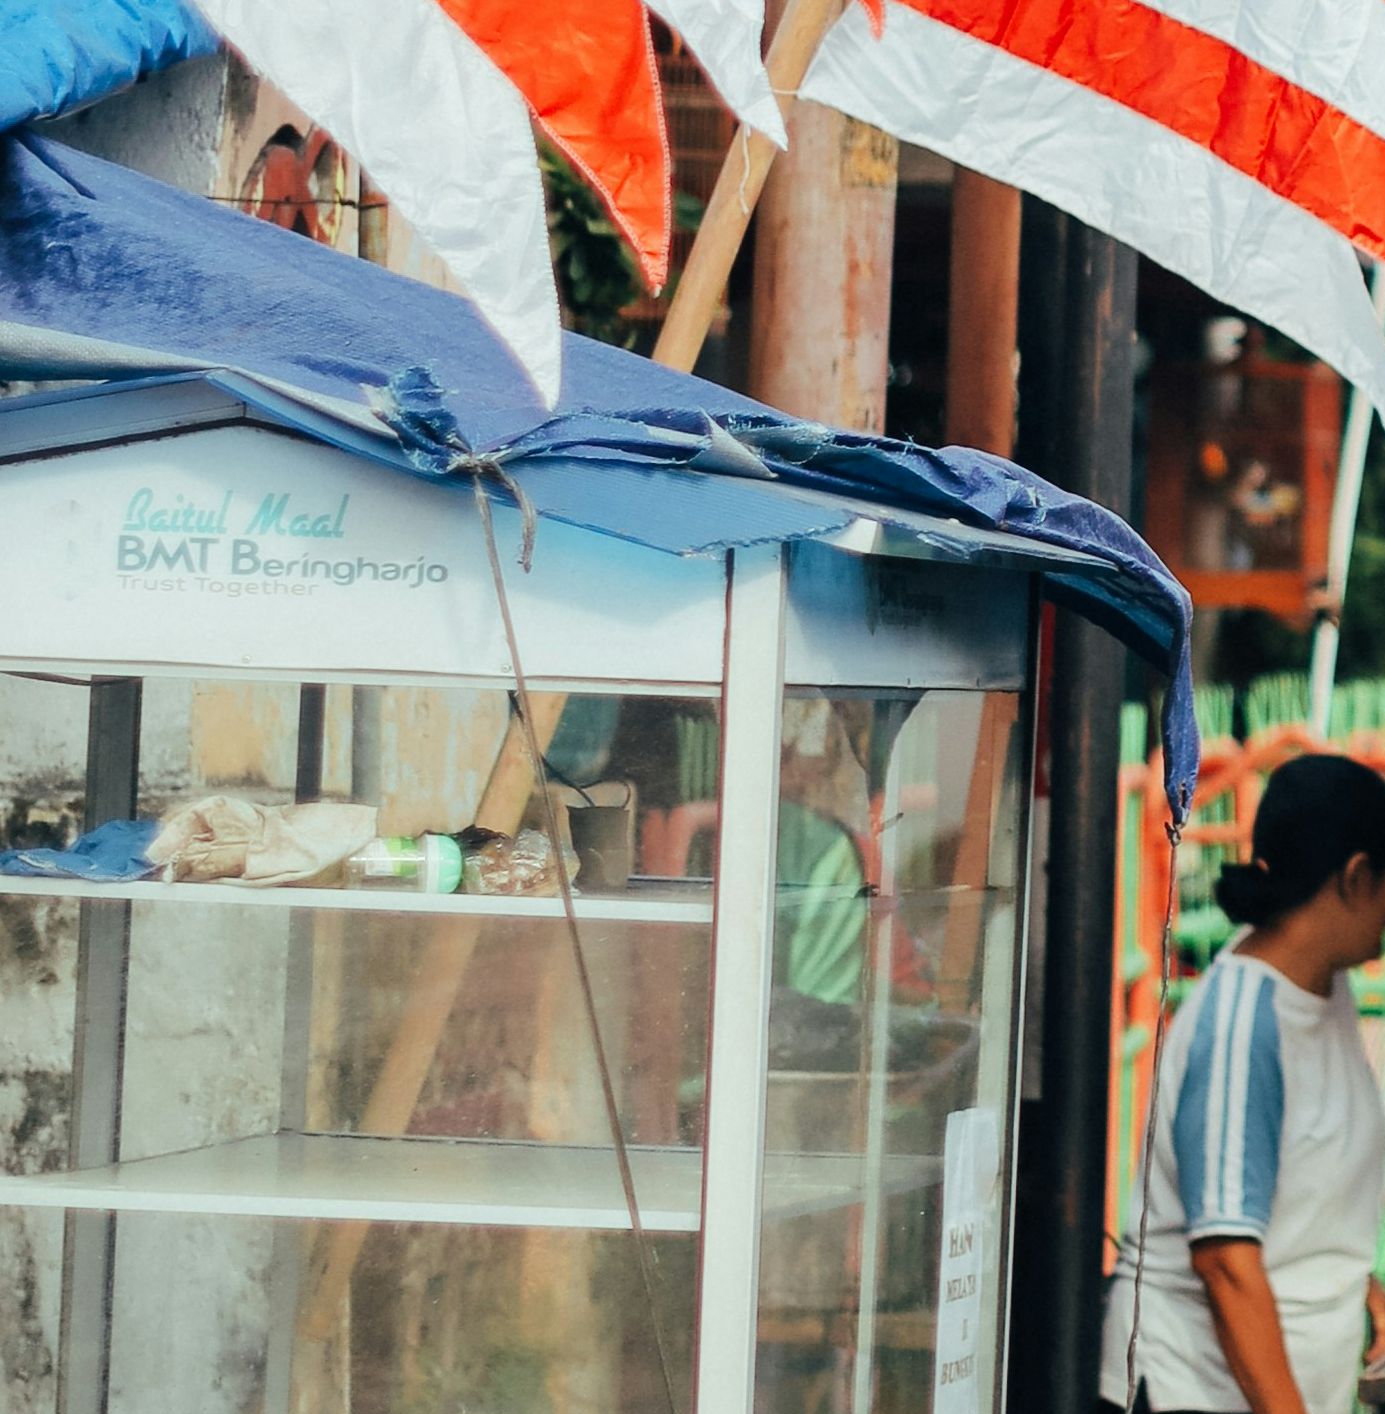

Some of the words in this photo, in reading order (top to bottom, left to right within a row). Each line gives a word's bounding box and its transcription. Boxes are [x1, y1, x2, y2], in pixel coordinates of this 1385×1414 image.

[122, 487, 233, 533] Baitul
[245, 493, 349, 538] Maal
[117, 535, 219, 574] BMT
[231, 538, 448, 588] Beringharjo
[117, 574, 187, 591] Trust
[195, 577, 319, 597] Together
